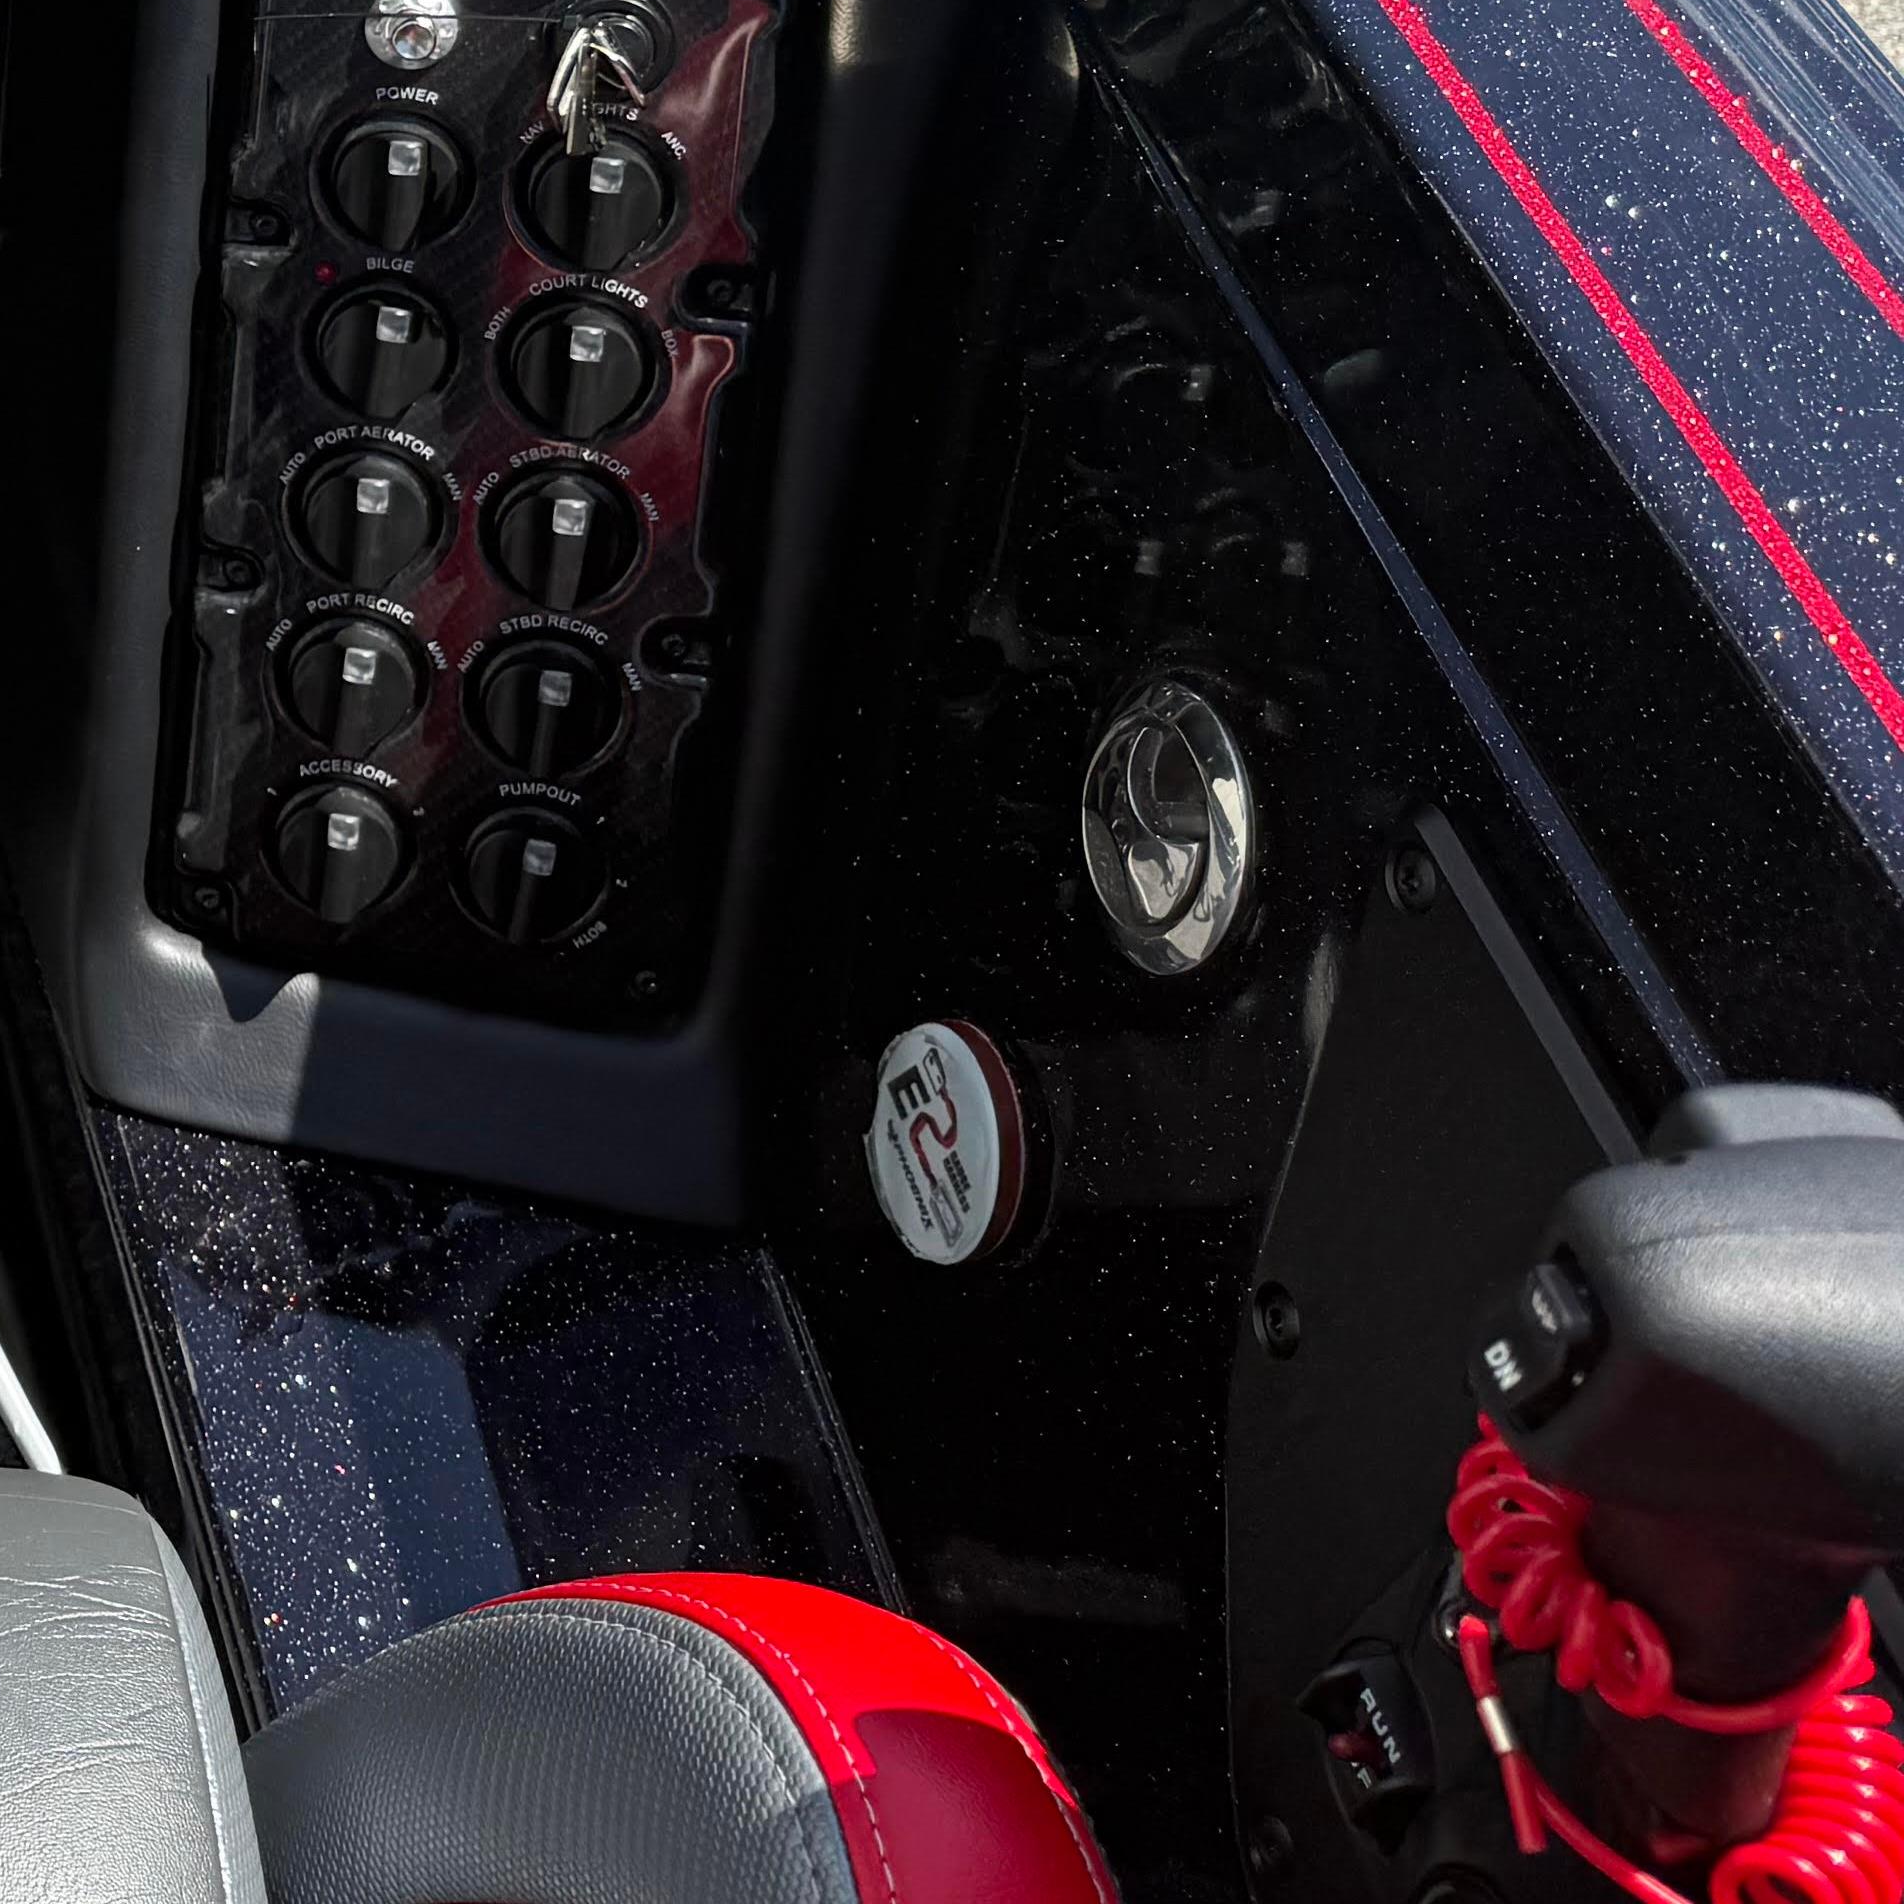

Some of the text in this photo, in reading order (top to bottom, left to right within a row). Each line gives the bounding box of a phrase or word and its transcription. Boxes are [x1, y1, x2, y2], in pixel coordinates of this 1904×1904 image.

[375, 86, 439, 105] POWER
[519, 120, 545, 146] NAV
[366, 257, 415, 274] BILGE
[529, 273, 649, 309] COURT LIGHTS
[483, 305, 513, 341] BOTH
[660, 328, 681, 358] BOX
[314, 425, 436, 461] PORT AERATOR
[279, 451, 306, 486] AUTO
[509, 445, 631, 480] STBD AERATOR
[443, 472, 463, 501] MAN
[473, 471, 500, 506] AUTO
[640, 492, 660, 522] MAN
[306, 592, 415, 626] PORT RECIRC
[265, 618, 292, 652] AUTO
[498, 614, 609, 646] STBD RECIRC
[427, 640, 448, 670] MAN
[457, 640, 485, 673] AUTO
[621, 662, 642, 691] MAN
[299, 758, 400, 788] ACCESSORY
[499, 782, 582, 806] PUMPOUT
[572, 920, 608, 949] BOTH
[1482, 1338, 1523, 1393] DN
[1359, 1686, 1403, 1766] RUN
